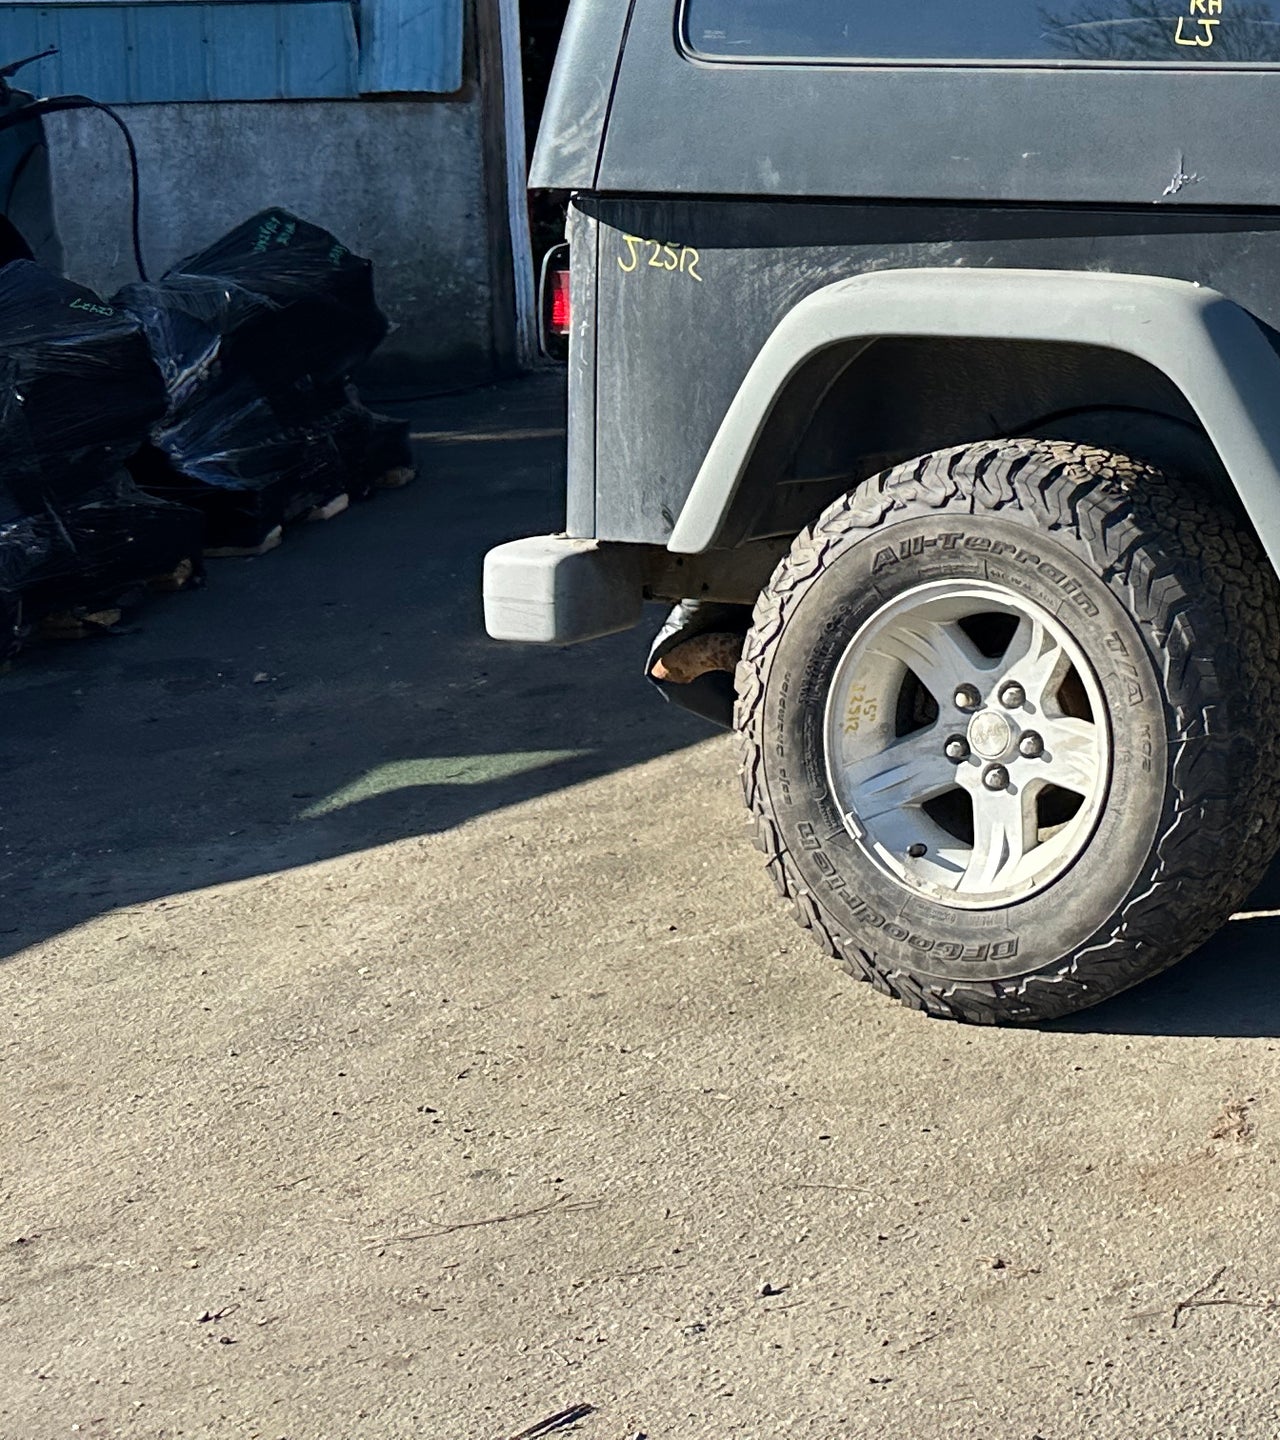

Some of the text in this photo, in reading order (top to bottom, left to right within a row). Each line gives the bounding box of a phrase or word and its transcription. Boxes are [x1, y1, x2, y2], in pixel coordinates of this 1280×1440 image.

[1174, 16, 1221, 47] LJ
[870, 531, 1101, 620] All-Terrain
[795, 818, 1021, 963] BFGoodrich
